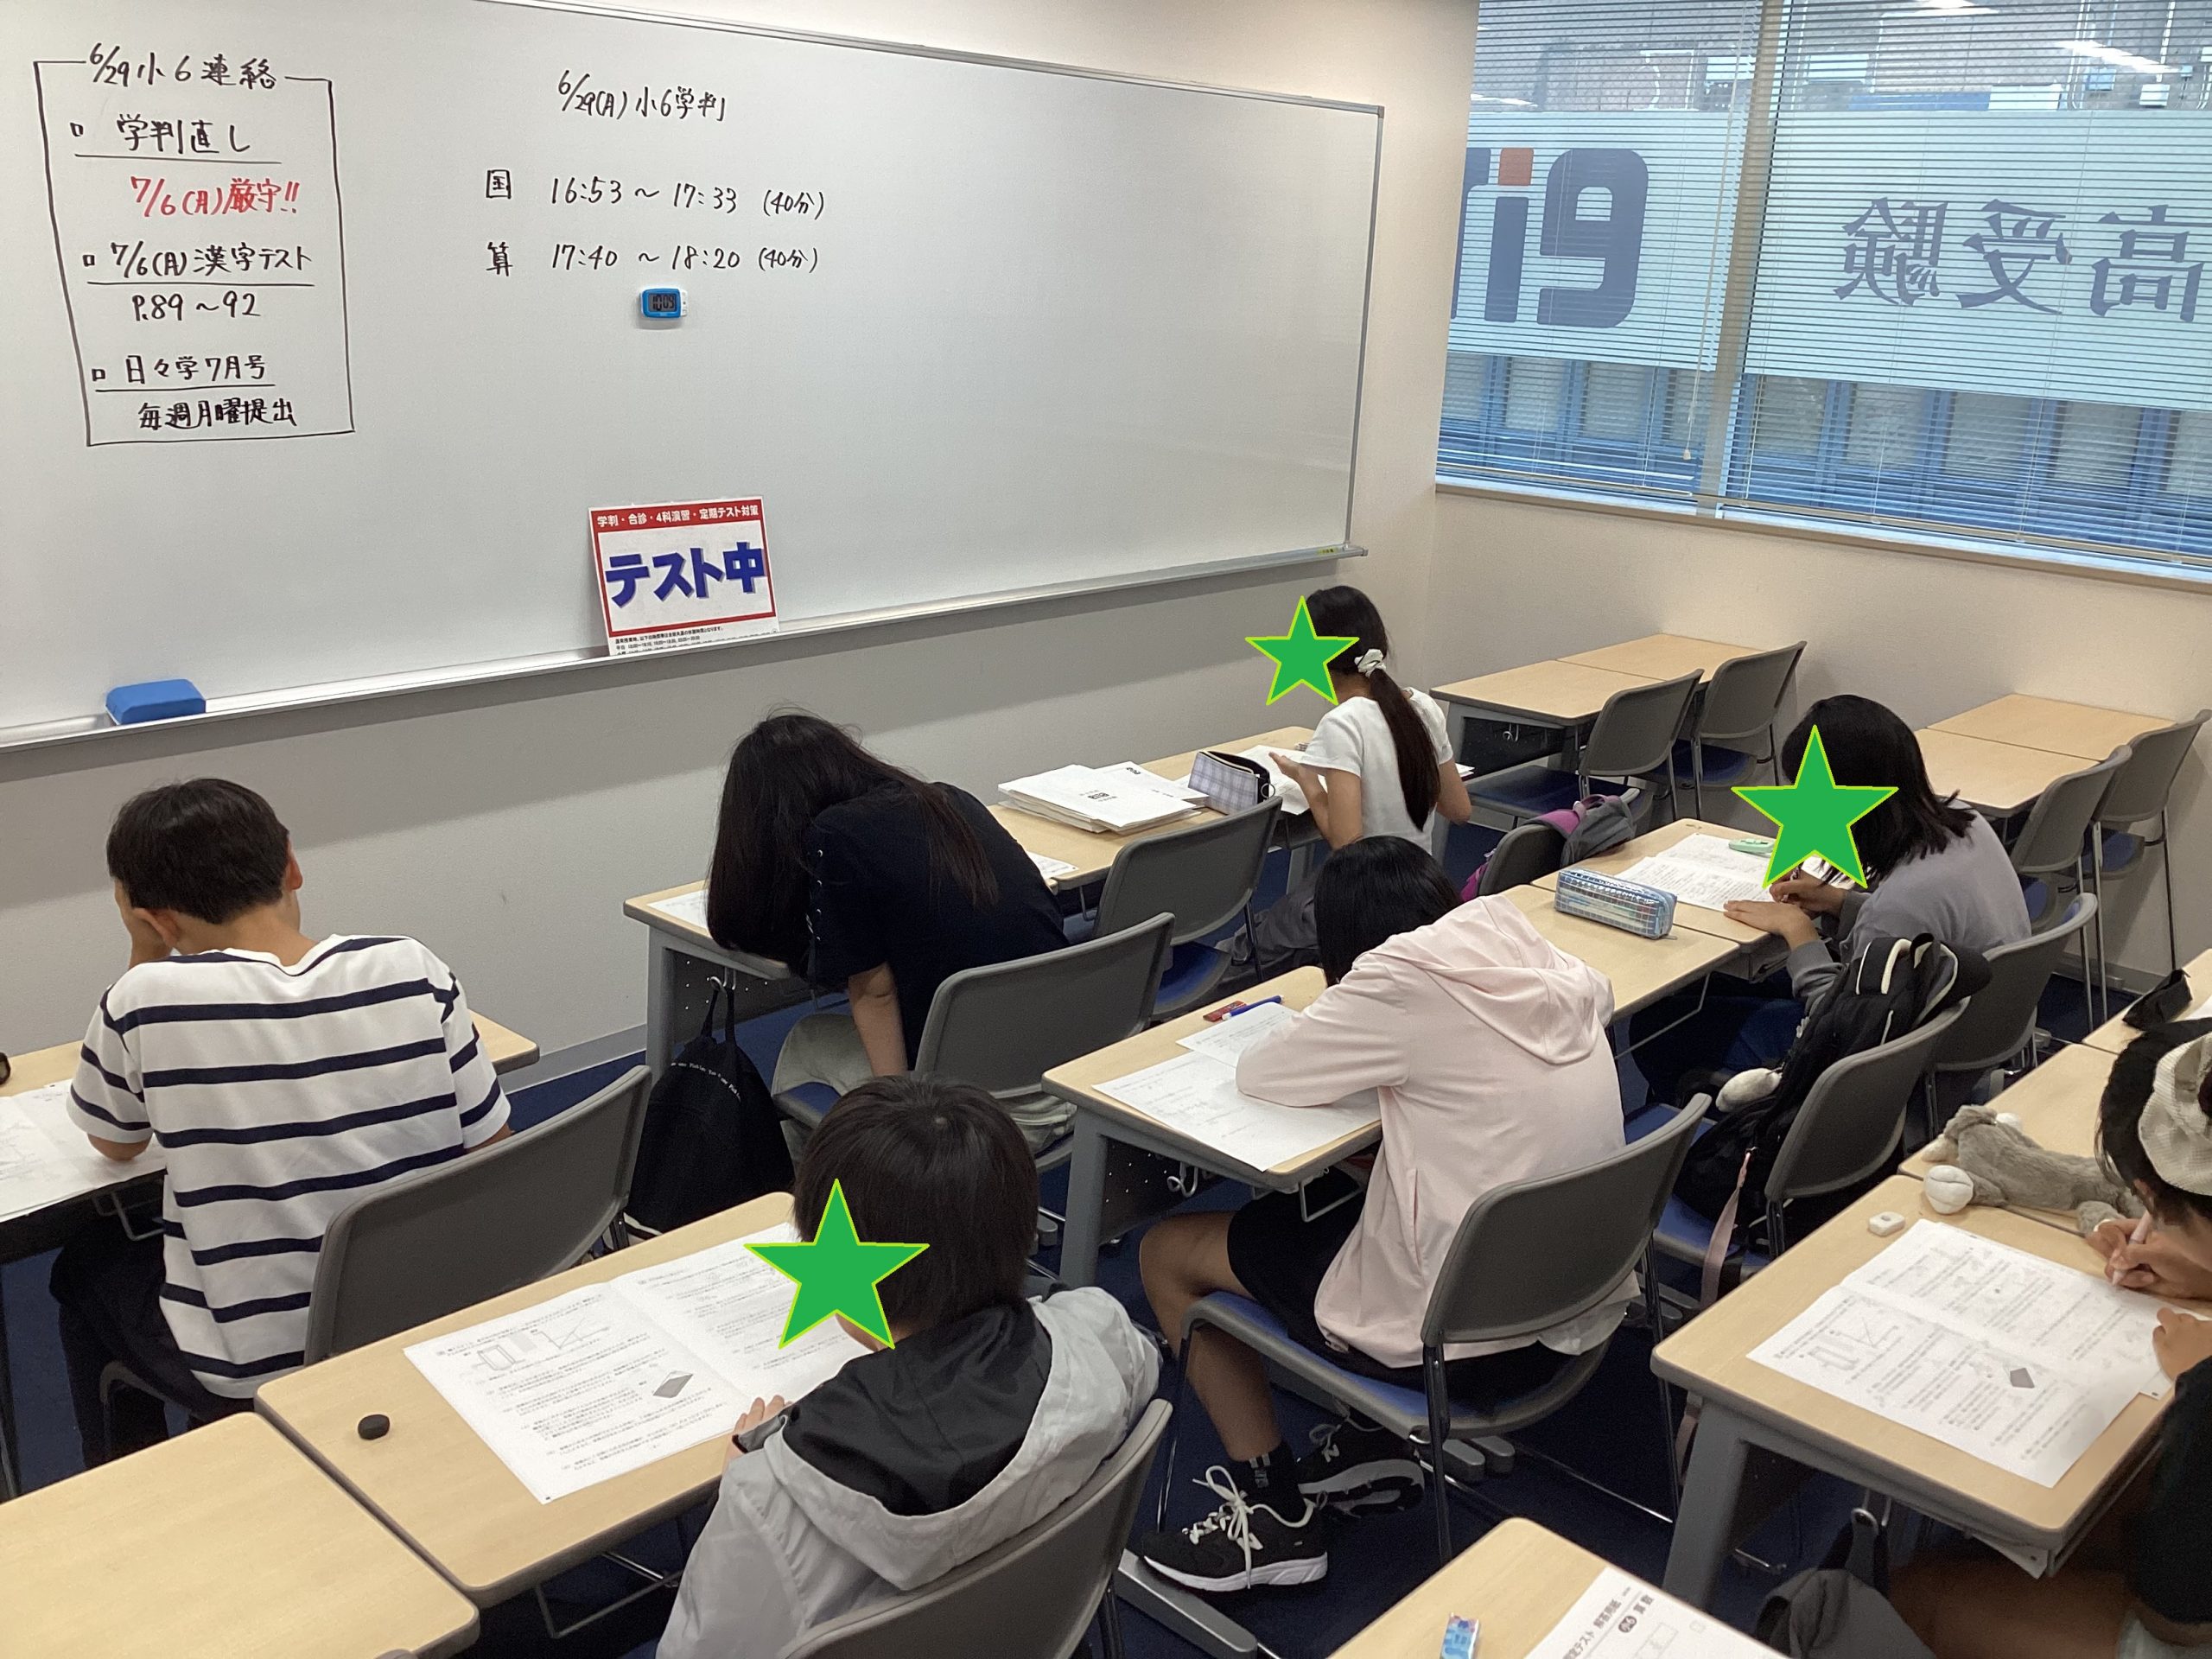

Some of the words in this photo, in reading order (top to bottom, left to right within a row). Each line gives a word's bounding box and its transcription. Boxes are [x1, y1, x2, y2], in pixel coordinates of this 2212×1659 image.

[117, 114, 251, 154] 学判直し
[486, 169, 512, 200] 国
[764, 190, 824, 220] (40分)
[486, 242, 513, 276] 算
[759, 247, 818, 273] (40分)
[126, 355, 266, 381] 日々学7月号
[138, 397, 297, 430] 毎週月曜提出
[606, 541, 768, 608] テスト中
